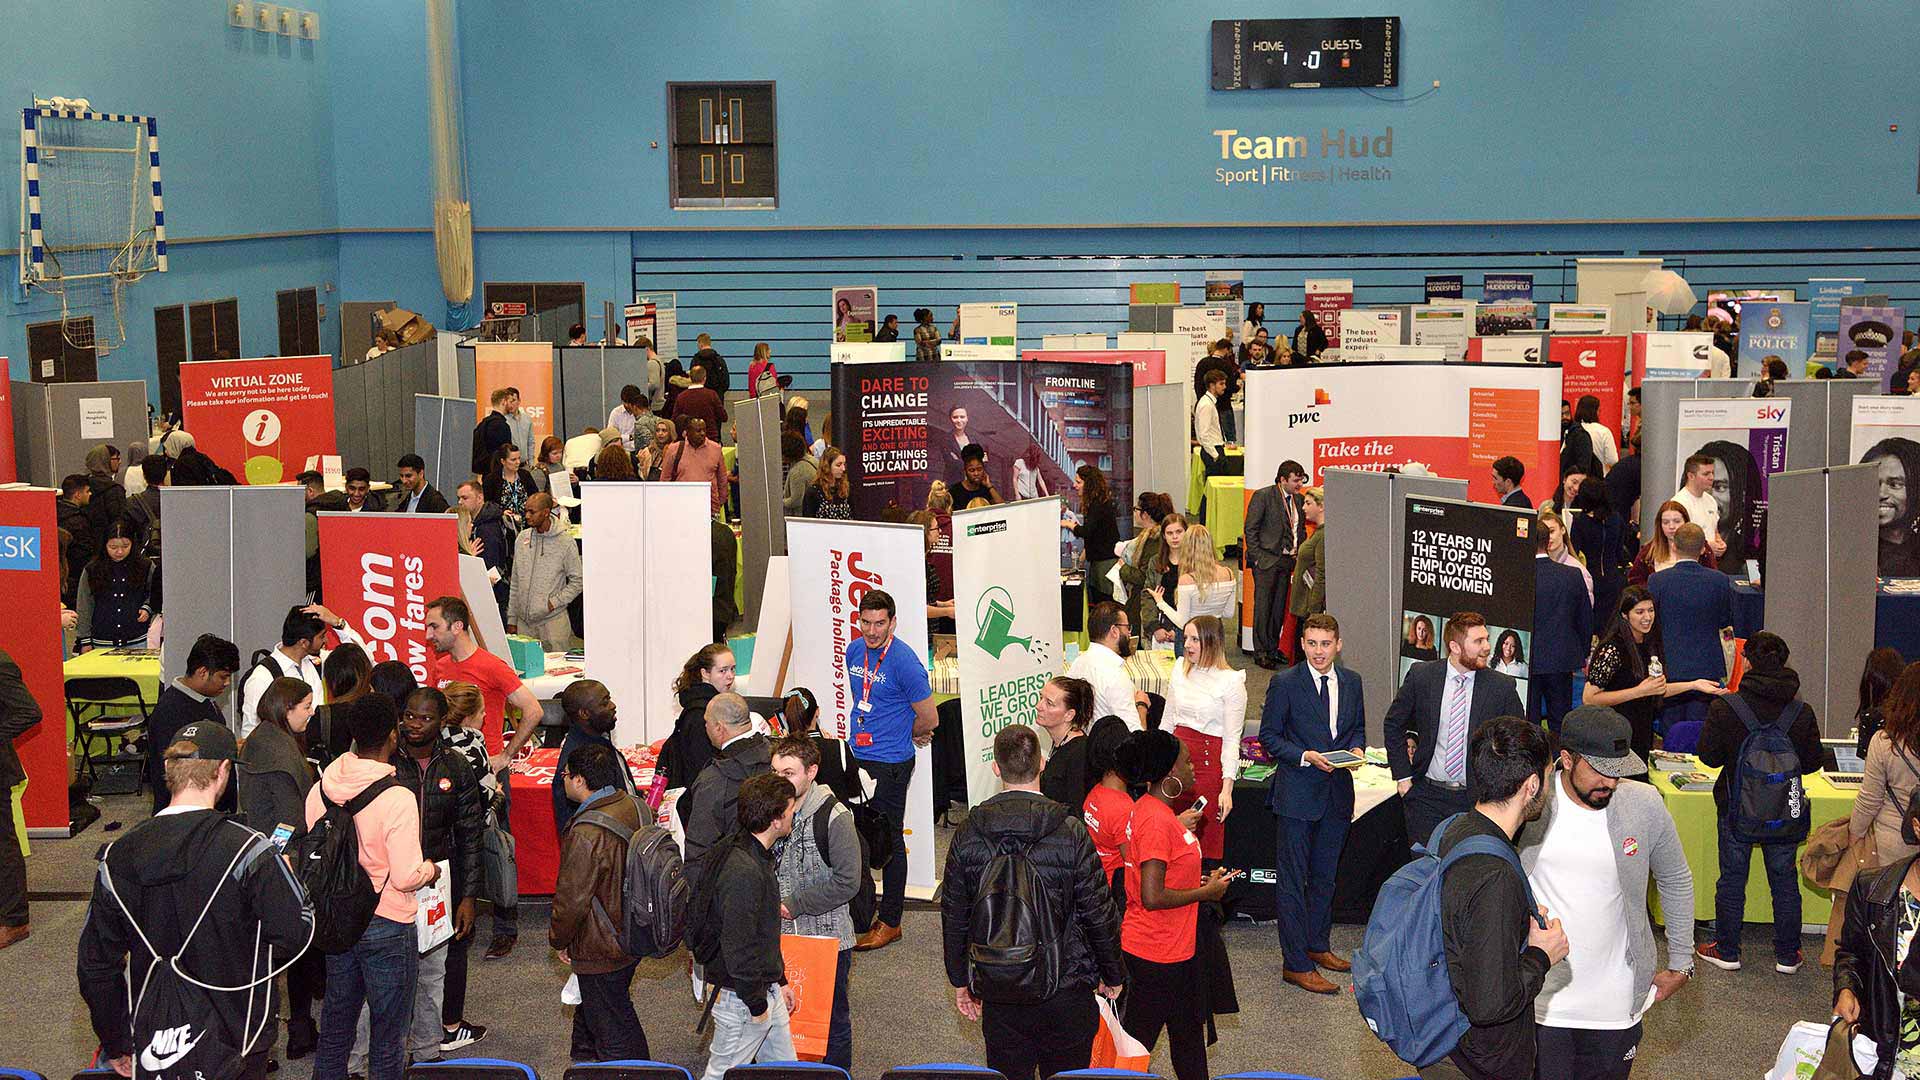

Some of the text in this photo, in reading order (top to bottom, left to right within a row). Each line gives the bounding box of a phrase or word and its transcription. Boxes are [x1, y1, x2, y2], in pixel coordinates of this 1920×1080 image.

[1253, 39, 1362, 51] HOME GUESTS
[1213, 127, 1393, 160] Team Hud
[1215, 166, 1391, 186] Sport Fitness Health
[1345, 336, 1378, 344] graduate
[1750, 339, 1798, 350] POLICE
[211, 374, 303, 388] VIRTUAL ZONE
[861, 377, 929, 394] DARE TO
[1045, 376, 1096, 388] FRONTLINE
[276, 386, 290, 394] here
[237, 396, 276, 404] information
[861, 392, 928, 409] CHANGE
[1288, 408, 1320, 428] pwc
[1756, 405, 1786, 422] sky
[874, 418, 928, 427] UNPREDICTABLE,
[862, 426, 927, 442] EXCITING
[880, 442, 896, 450] ONE
[912, 440, 927, 448] THE
[1318, 440, 1394, 458] Take the
[1772, 434, 1783, 469] Tristan
[862, 449, 928, 462] BEST THINGS
[862, 460, 928, 474] YOU CAN DO
[1413, 505, 1444, 514] enterprise
[968, 522, 1006, 535] enterprise
[0, 536, 36, 559] SK
[1412, 530, 1492, 552] 12 YEARS IN
[1411, 543, 1486, 566] THE TOP 50
[1411, 556, 1492, 581] EMPLOYERS
[1410, 570, 1494, 596] FOR WOMEN
[401, 556, 428, 688] ow fares
[830, 549, 846, 740] Package holidays you can
[980, 671, 1053, 704] LEADERS?
[980, 692, 1039, 721] WE GRO
[1017, 709, 1038, 725] OW
[1788, 776, 1800, 818] adidas
[152, 1024, 191, 1055] NIKE
